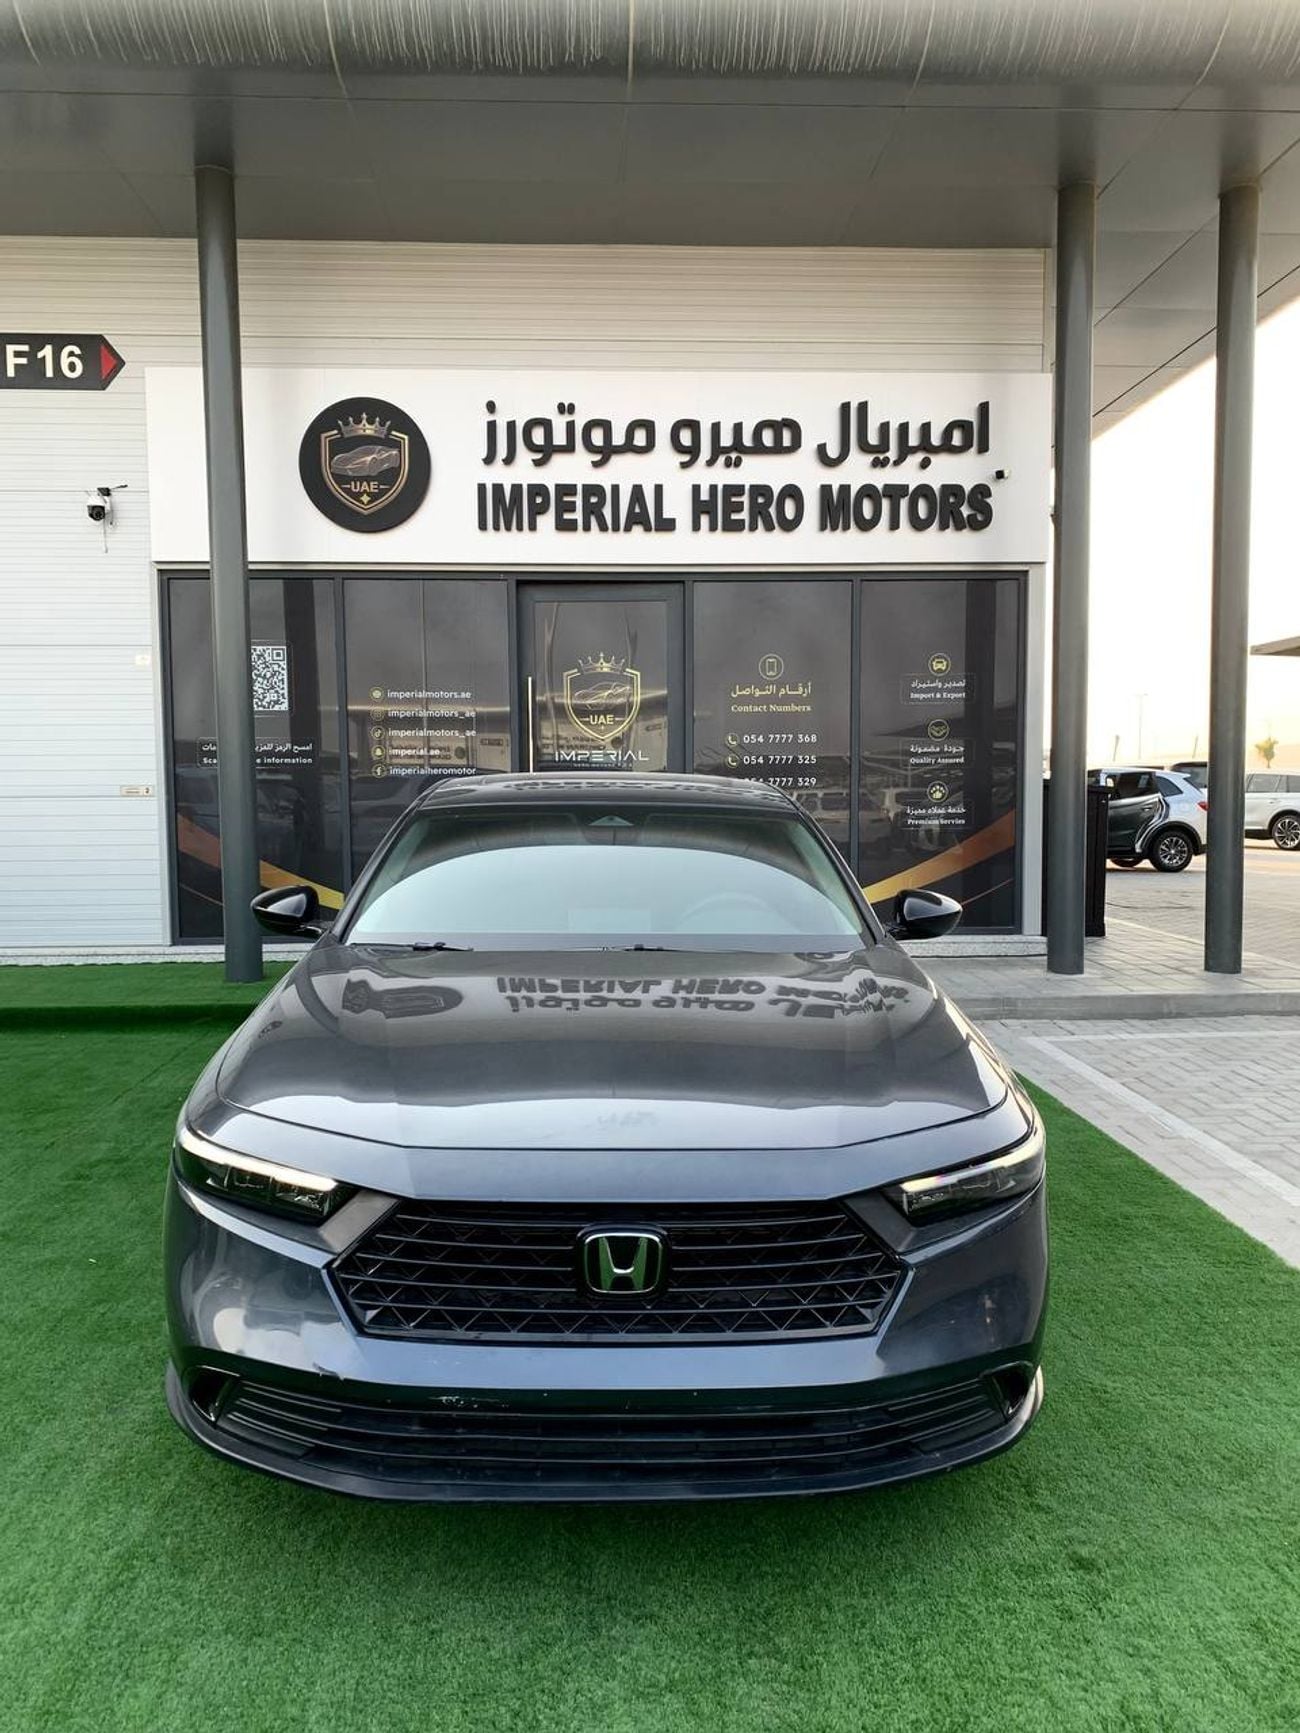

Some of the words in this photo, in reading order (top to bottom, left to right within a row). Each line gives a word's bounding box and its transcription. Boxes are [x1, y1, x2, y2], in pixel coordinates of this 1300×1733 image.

[481, 400, 656, 468] موتورز
[817, 400, 990, 469] امبريال
[670, 417, 802, 469] هيرو
[351, 481, 379, 492] UAE
[477, 483, 676, 533] IMPERIAL
[691, 483, 804, 533] HERO
[818, 483, 993, 532] MOTORS
[387, 689, 471, 699] imperialmotors.ae
[910, 692, 934, 700] Import
[731, 703, 767, 712] Contact
[769, 703, 811, 712] Numbers
[590, 715, 614, 725] UAE
[388, 728, 476, 738] imperialmotors_ae
[743, 735, 764, 743] 054
[768, 735, 793, 743] 7777
[797, 734, 817, 743] 368
[555, 750, 648, 761] IMPERIAL
[743, 756, 764, 764] 054
[768, 756, 793, 764] 7777
[797, 756, 817, 764] 325
[910, 756, 936, 765] Quality
[937, 756, 964, 764] Assured
[797, 777, 817, 786] 329
